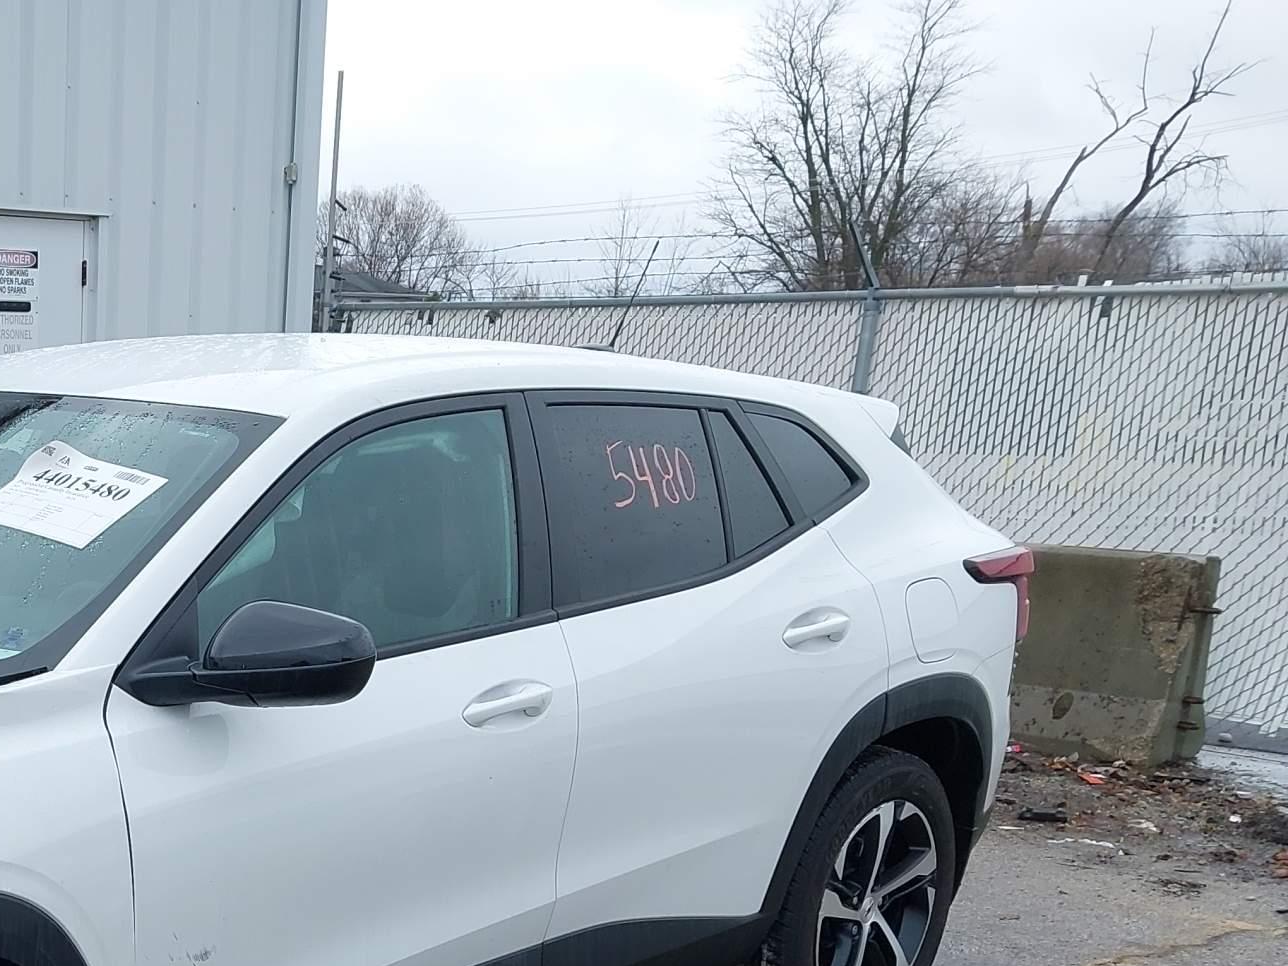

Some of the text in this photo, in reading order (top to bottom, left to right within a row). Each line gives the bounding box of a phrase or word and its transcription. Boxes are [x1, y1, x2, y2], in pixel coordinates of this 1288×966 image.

[6, 269, 29, 277] SMOKING
[0, 277, 13, 285] OPEN
[15, 278, 34, 286] FLAMES
[0, 286, 27, 294] NO SPARKS
[4, 344, 22, 354] ONLY
[607, 440, 696, 508] 5480
[32, 469, 131, 501] 44015480
